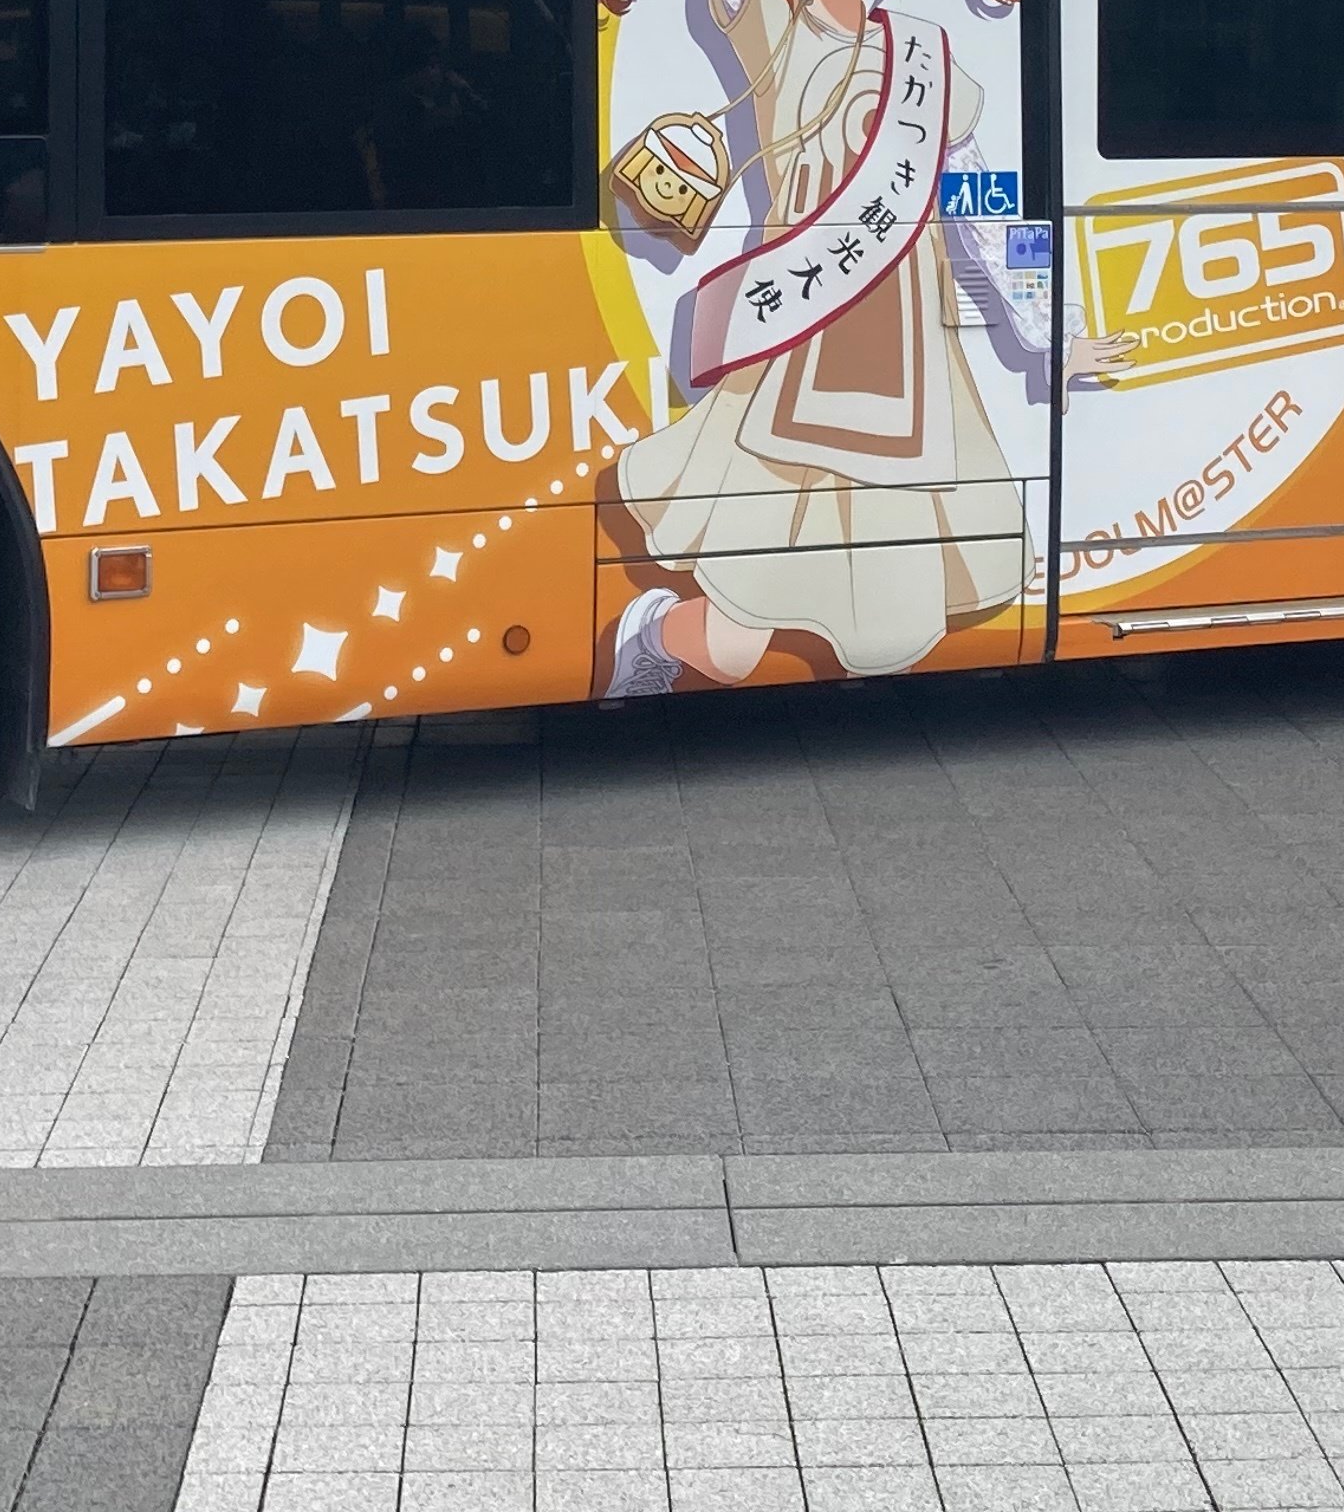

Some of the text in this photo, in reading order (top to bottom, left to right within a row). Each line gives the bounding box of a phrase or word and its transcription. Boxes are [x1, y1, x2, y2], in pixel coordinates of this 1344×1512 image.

[1009, 226, 1049, 240] PiTaPa
[1093, 194, 1336, 315] 765
[4, 268, 391, 401] YAYOI
[14, 355, 673, 535] TAKATSUKI
